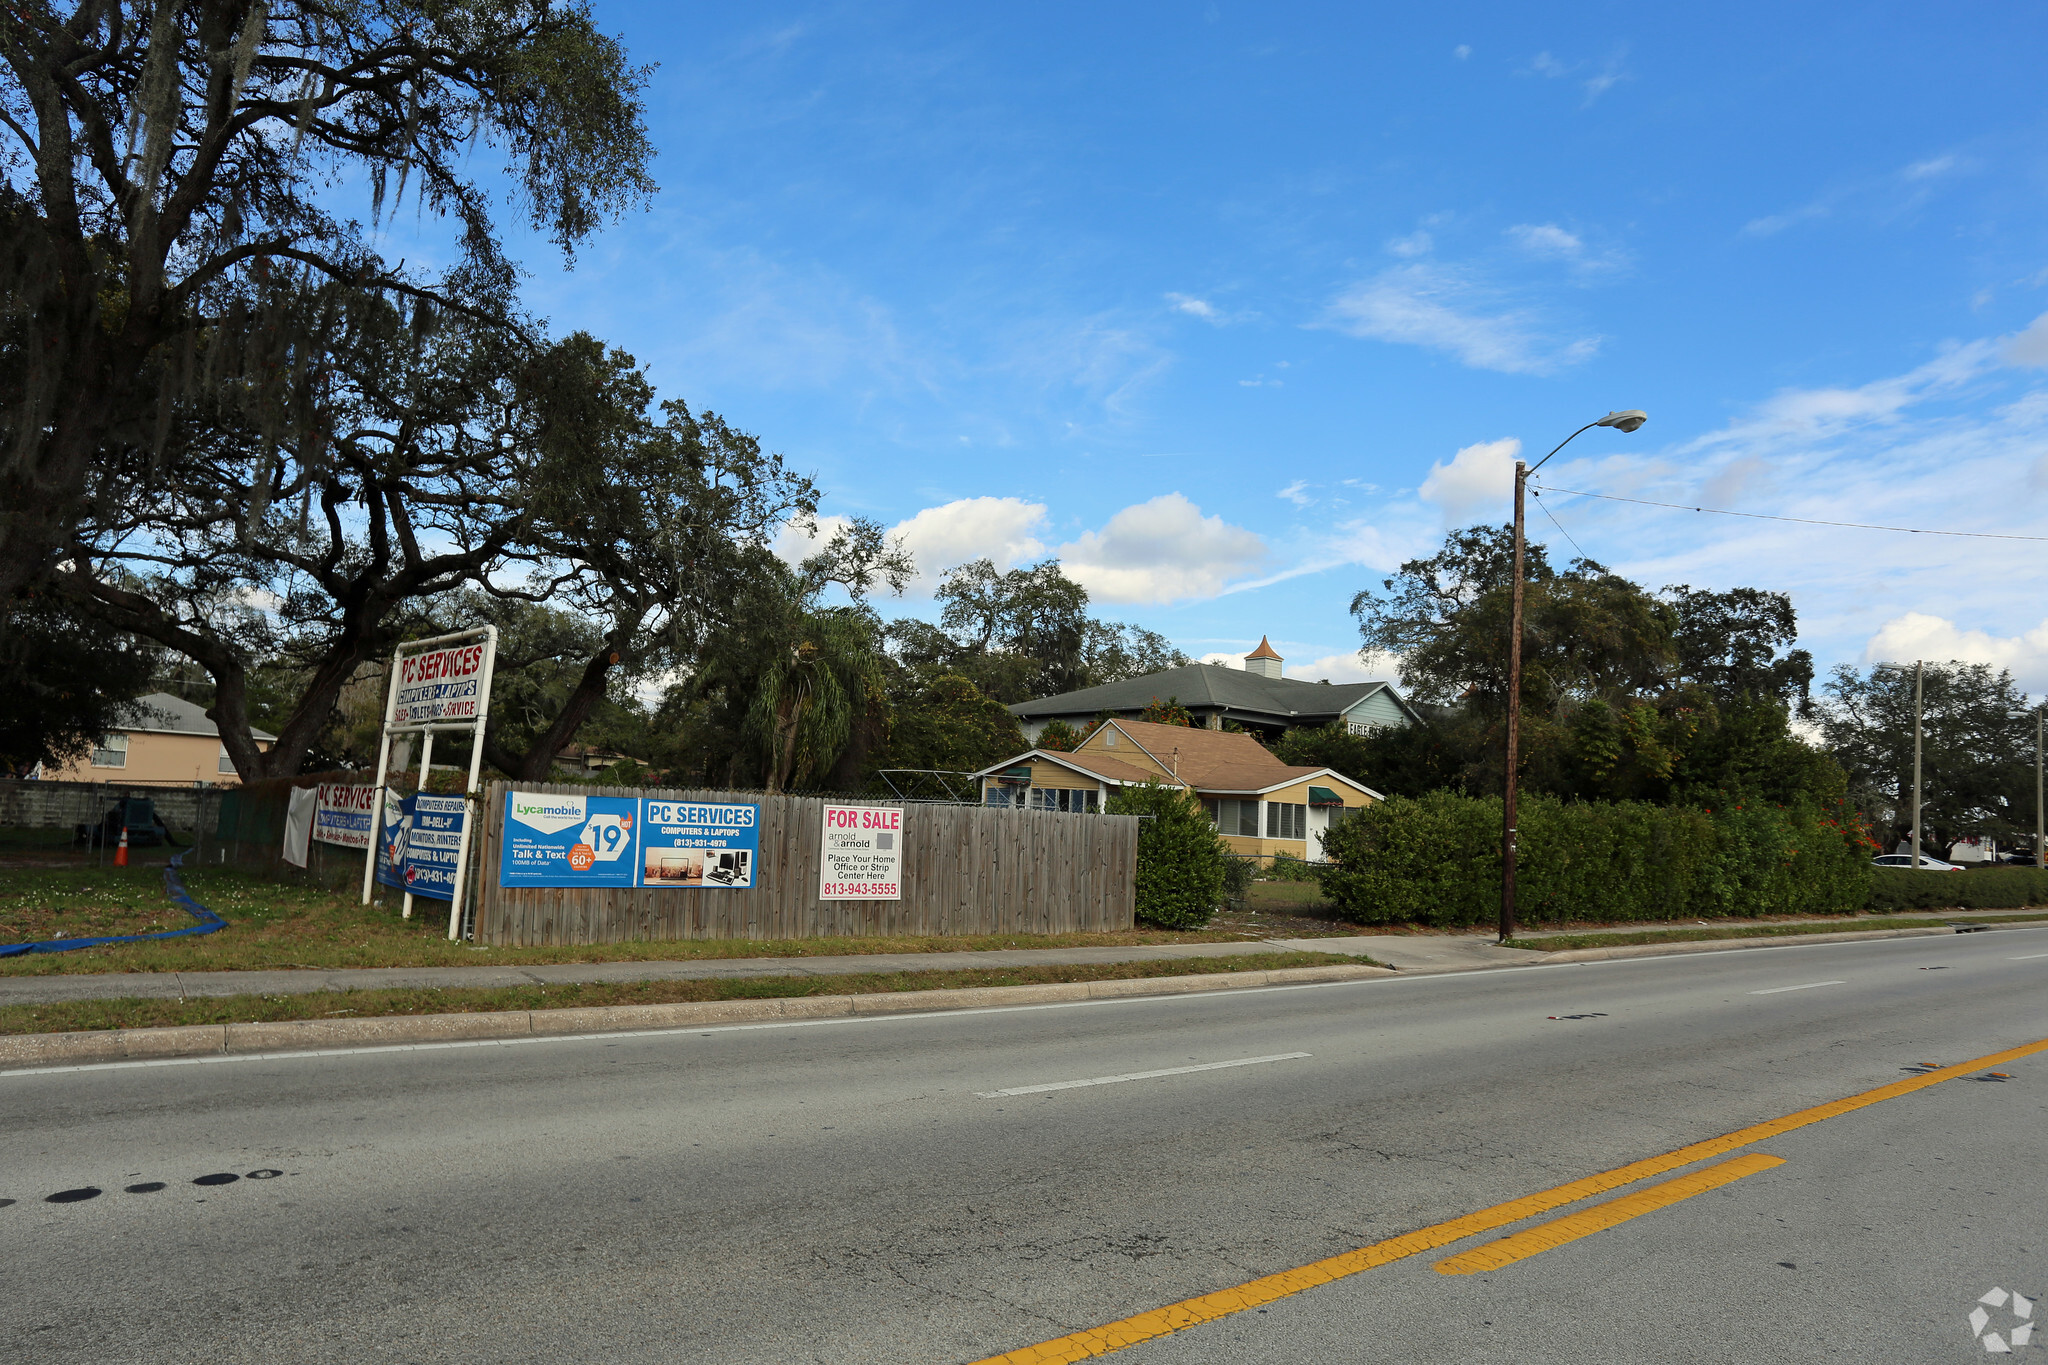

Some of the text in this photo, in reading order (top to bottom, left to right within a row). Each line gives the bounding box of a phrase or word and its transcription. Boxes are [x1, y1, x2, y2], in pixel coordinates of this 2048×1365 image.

[402, 646, 482, 683] PC SERVICES
[319, 785, 330, 807] PC
[517, 803, 581, 815] Lycamobile
[650, 805, 752, 825] PC SERVICES
[828, 810, 899, 829] FOR SALE
[620, 820, 632, 828] HOT
[661, 826, 740, 836] COMPUTERS & LAPTOPS
[828, 832, 856, 840] arnold
[432, 850, 438, 862] &
[512, 850, 566, 860] Talk & Text
[572, 855, 592, 866] 60+
[828, 854, 896, 863] Place Your Home
[834, 862, 858, 871] Office
[870, 864, 889, 873] Strip
[838, 872, 885, 880] Center Here
[824, 882, 896, 894] 813-943-5555
